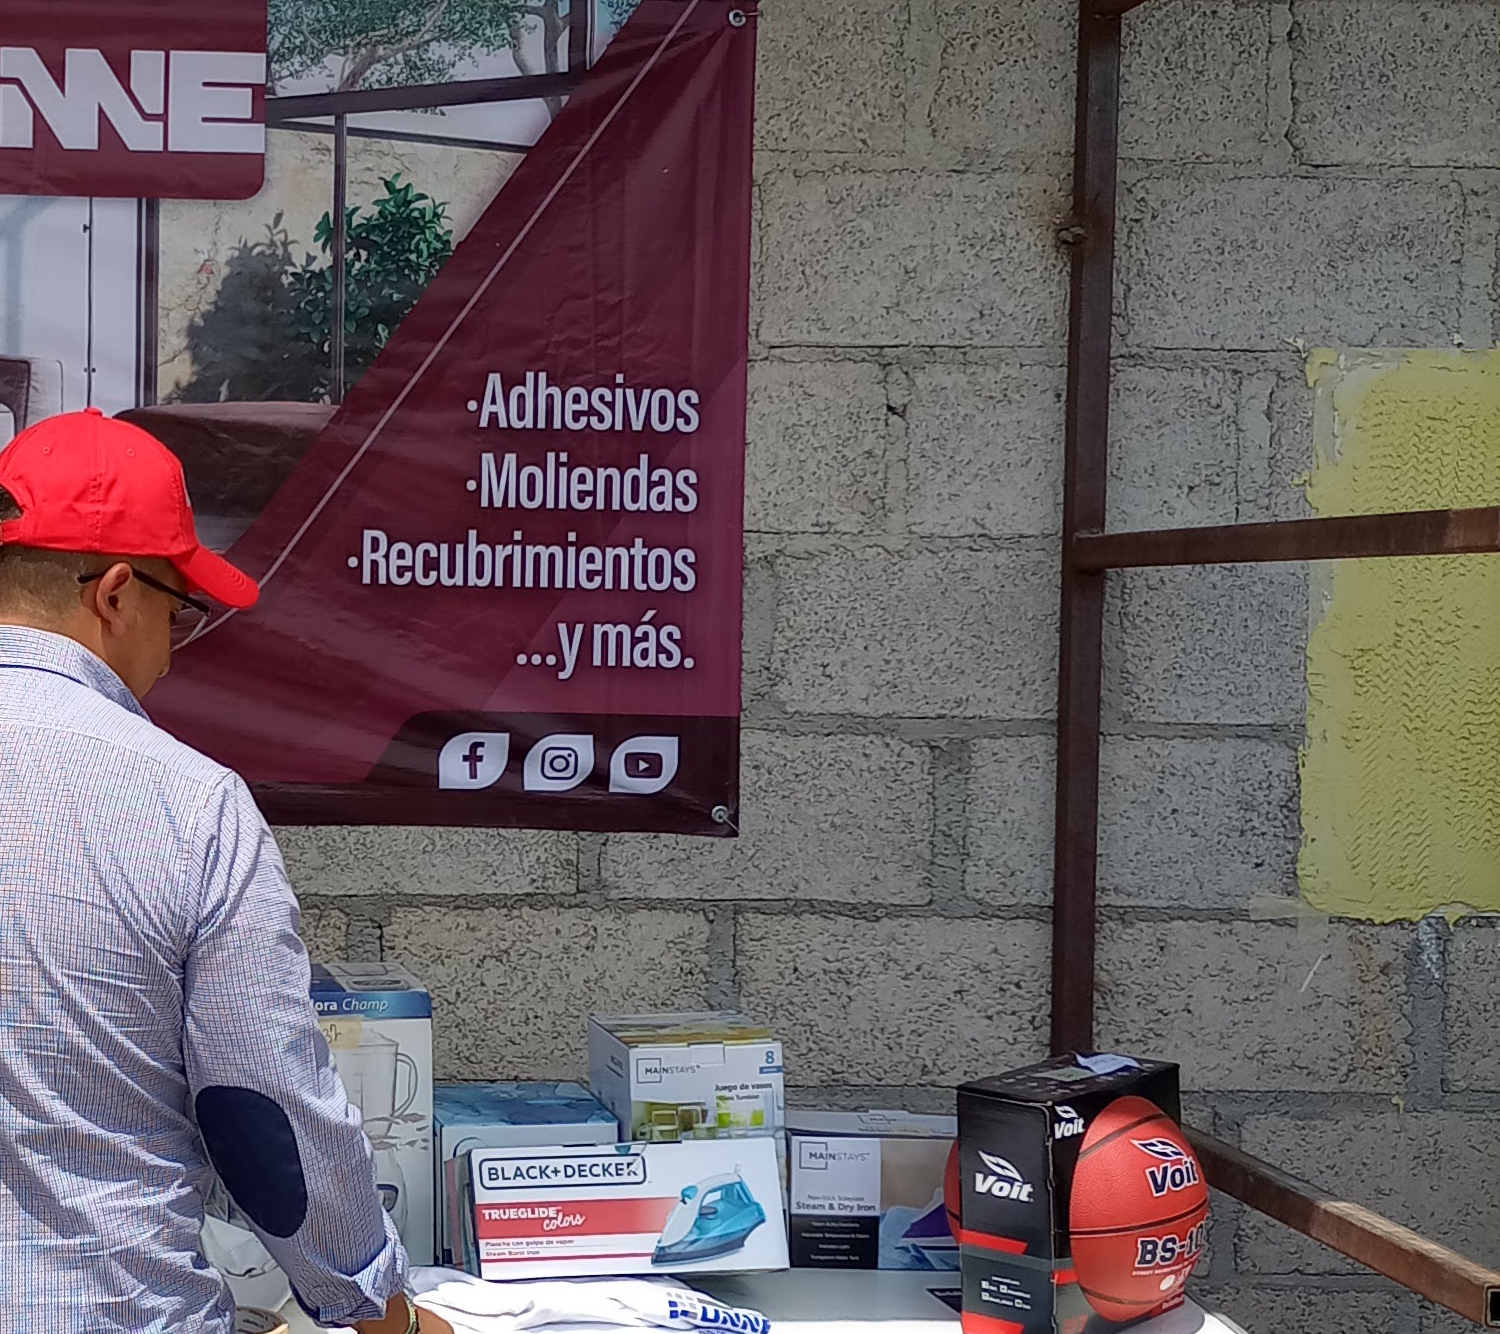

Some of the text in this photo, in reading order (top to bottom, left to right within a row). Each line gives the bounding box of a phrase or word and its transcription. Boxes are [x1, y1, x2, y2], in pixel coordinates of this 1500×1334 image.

[592, 609, 696, 670] más.
[341, 997, 389, 1015] Champ
[765, 1050, 775, 1065] 8
[1054, 1117, 1085, 1140] Voit
[808, 1151, 868, 1162] MAINSTAYS
[487, 1161, 639, 1182] BLACK+DECKER
[1145, 1155, 1199, 1198] Voit
[973, 1171, 1033, 1203] Voit
[481, 1206, 558, 1221] TRUEGLIDE
[795, 1201, 877, 1212] Steam & Dry Iron
[542, 1212, 586, 1231] colors
